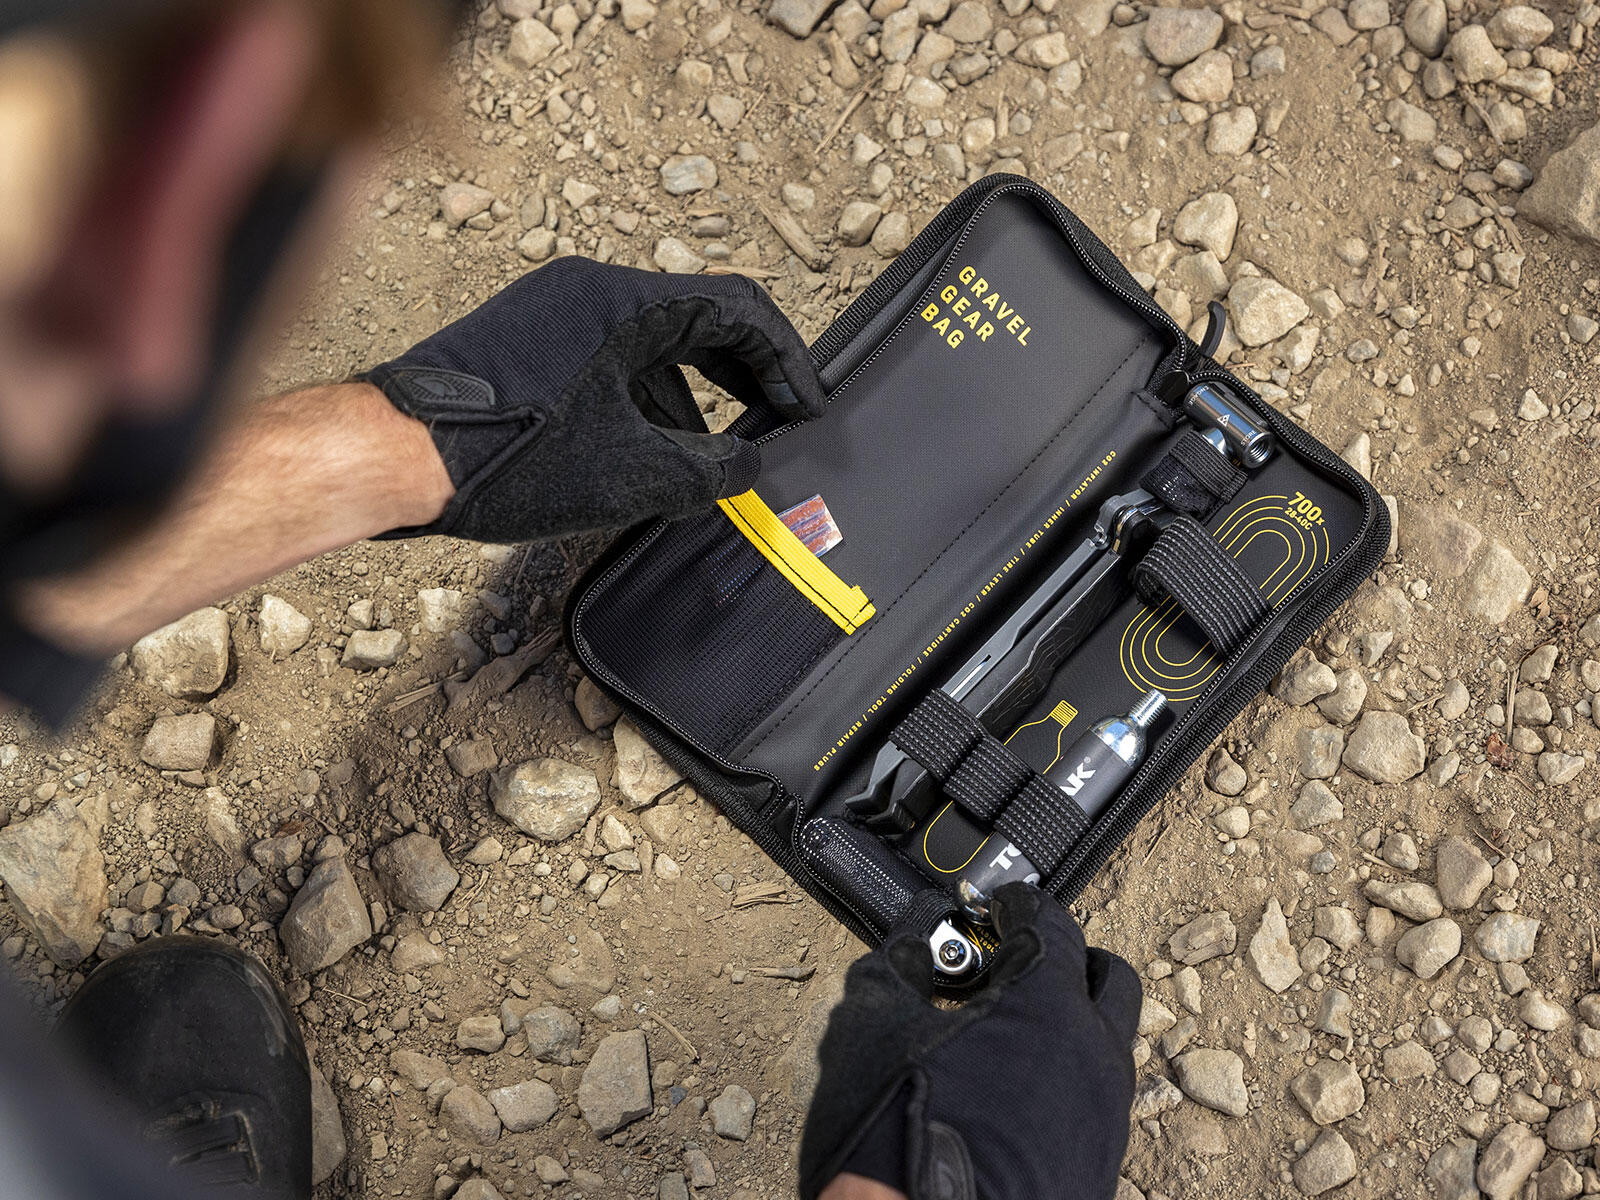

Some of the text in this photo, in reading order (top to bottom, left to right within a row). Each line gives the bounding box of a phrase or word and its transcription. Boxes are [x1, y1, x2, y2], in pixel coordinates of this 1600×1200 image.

[939, 284, 995, 343] GEAR
[958, 265, 1032, 347] GRAVEL
[920, 302, 965, 350] BAG
[1101, 450, 1117, 466] CO2
[1070, 465, 1103, 500] INFLATOR
[1043, 506, 1065, 530] INNER
[1024, 529, 1045, 549] TUBE
[1002, 555, 1020, 573] TIRE
[980, 572, 1004, 596] LEVER
[959, 601, 976, 618] CO2
[922, 617, 960, 657] CARTRIDGE
[886, 664, 917, 695] FOLDING
[866, 695, 887, 714] TOOL
[837, 720, 863, 747] REPAIR
[813, 747, 837, 771] PLUGS
[979, 937, 995, 954] TOOL
